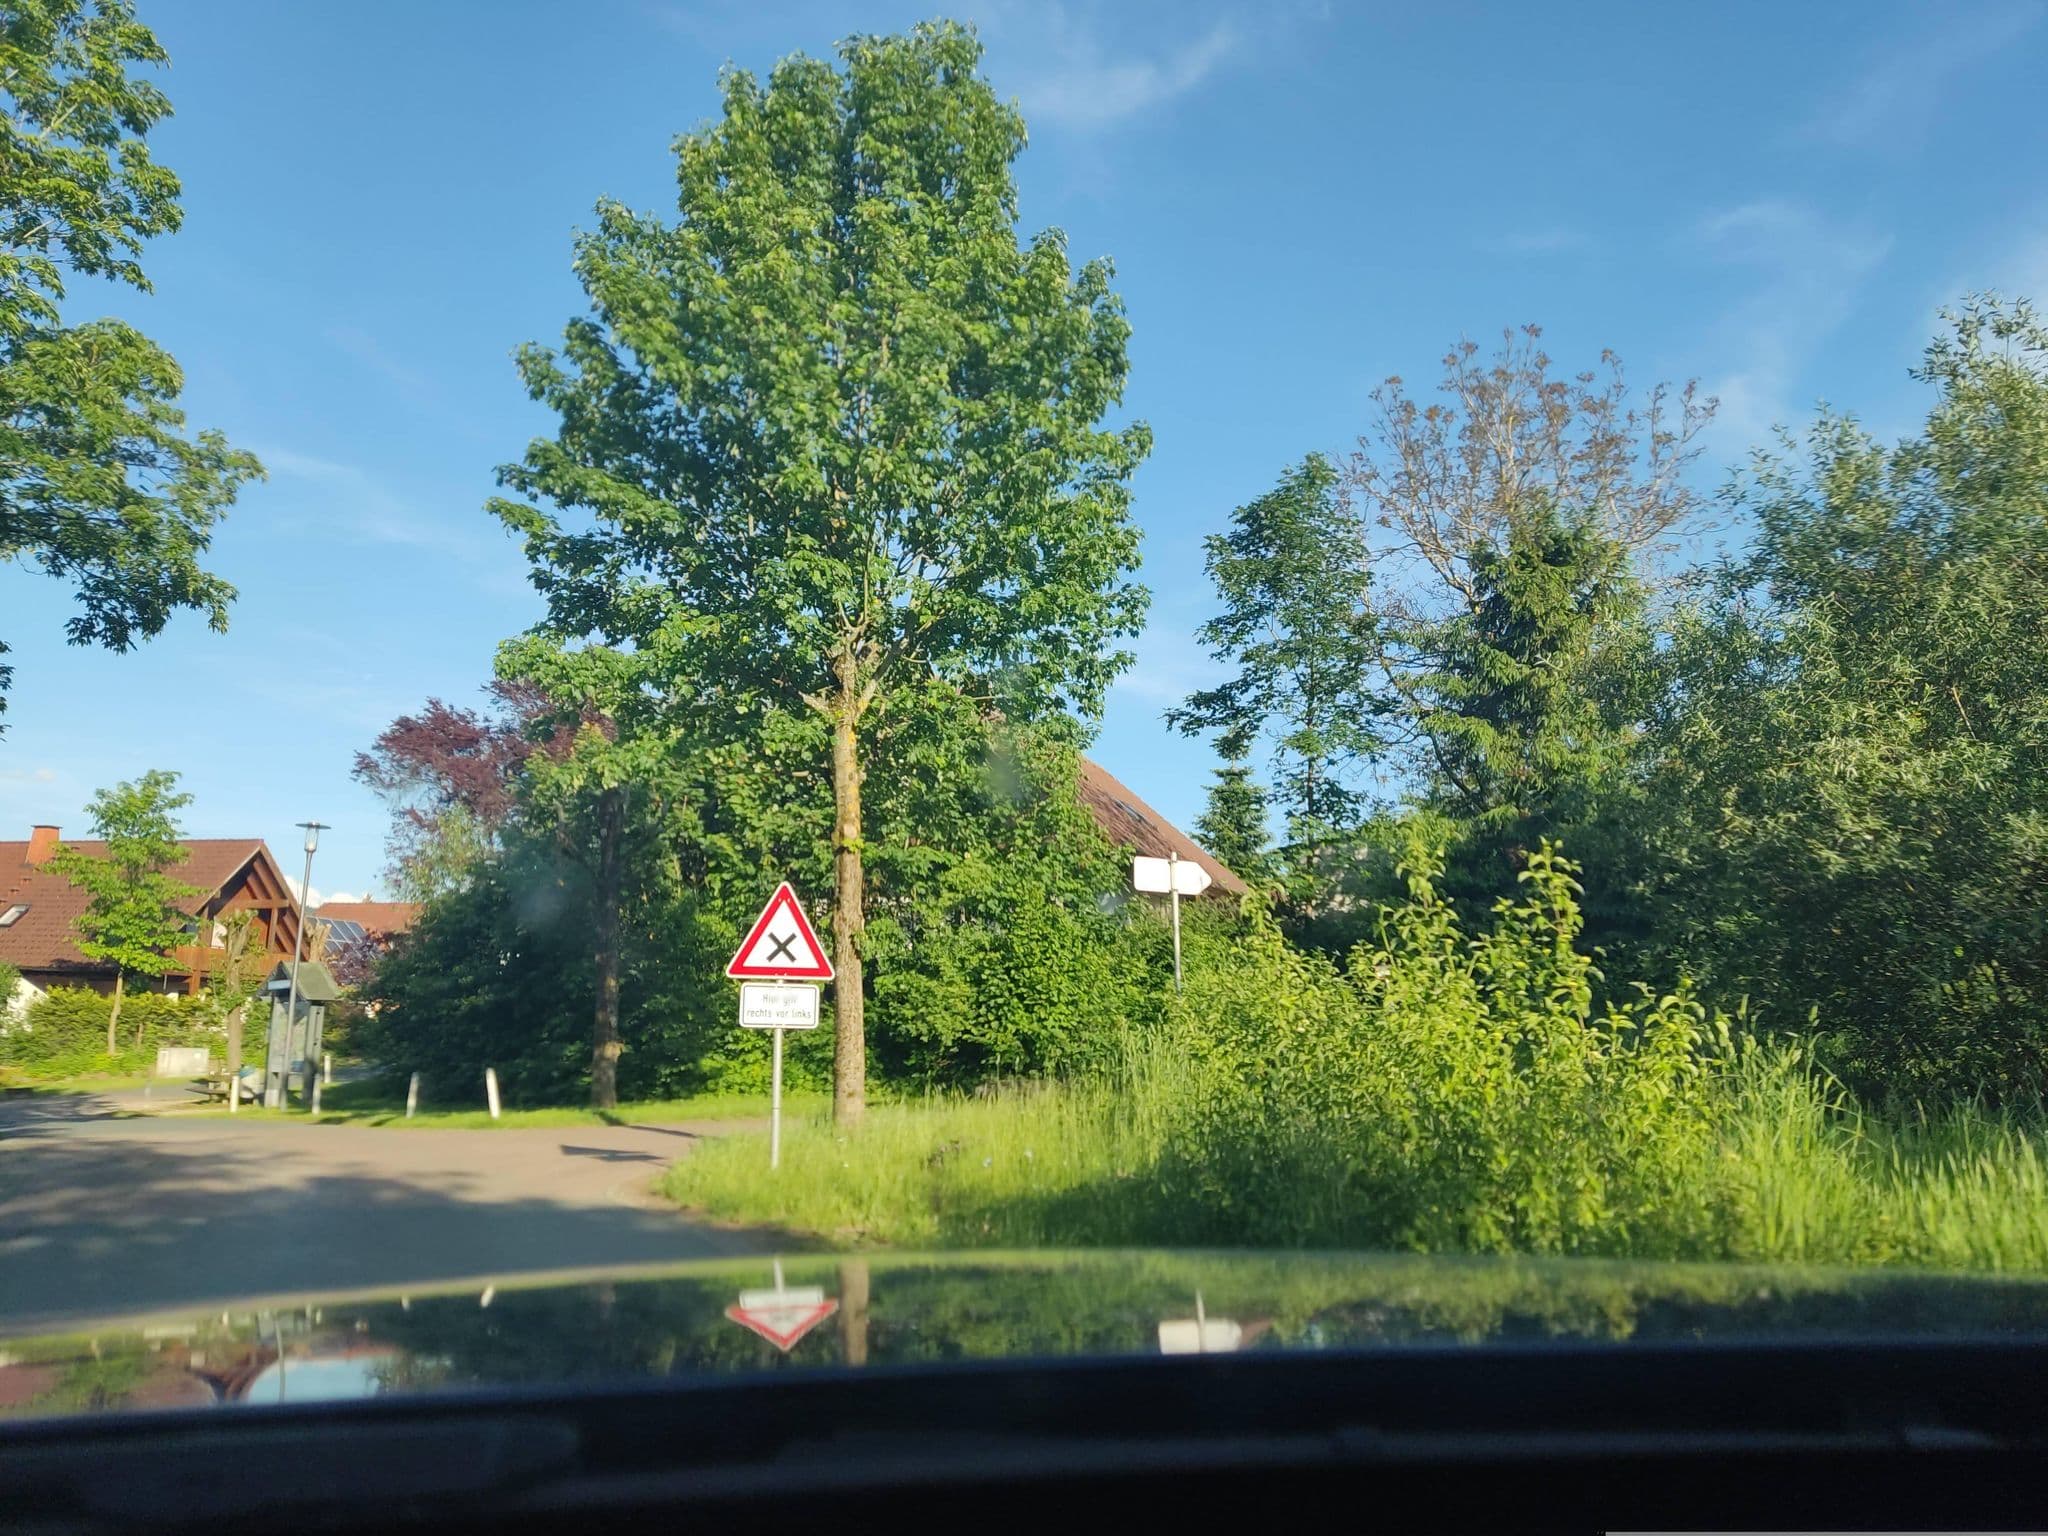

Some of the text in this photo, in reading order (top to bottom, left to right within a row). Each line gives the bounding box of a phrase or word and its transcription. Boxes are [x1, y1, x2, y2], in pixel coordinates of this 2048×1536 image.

[746, 1009, 812, 1019] rechts vor links
